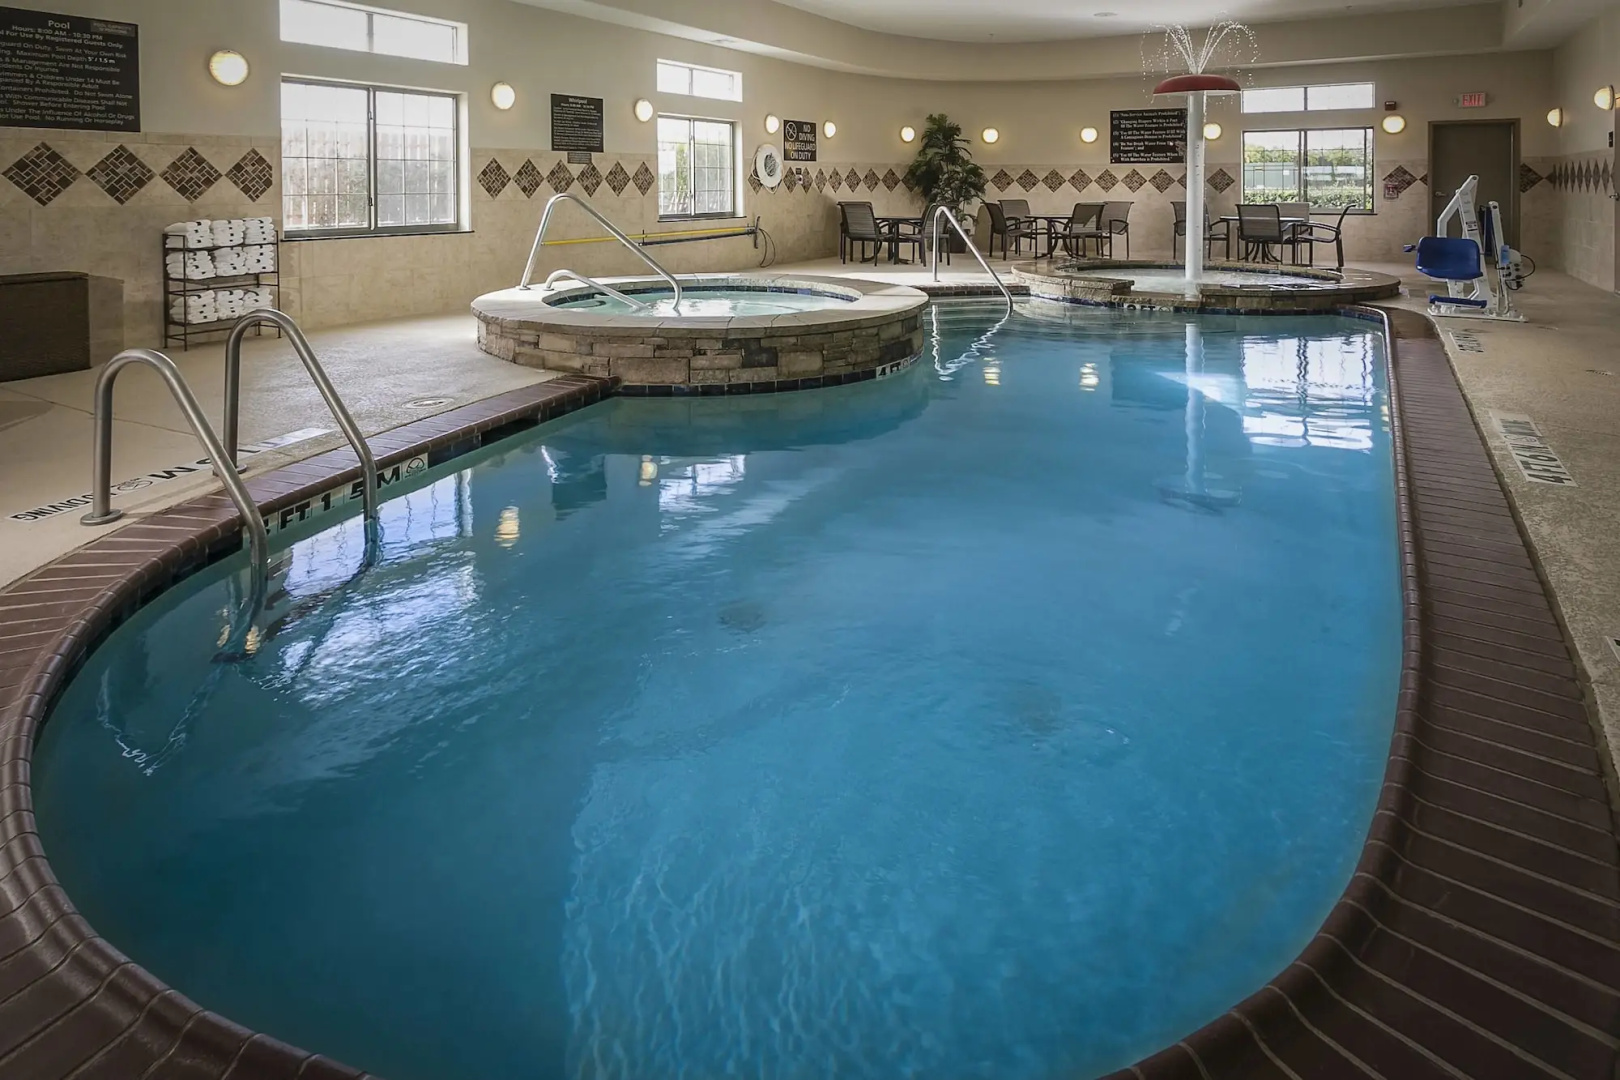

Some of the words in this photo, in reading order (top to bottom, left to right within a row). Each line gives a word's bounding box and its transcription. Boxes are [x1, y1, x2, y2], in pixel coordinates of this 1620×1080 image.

[48, 20, 70, 29] Pool
[1462, 93, 1484, 106] EXIT
[798, 133, 815, 141] DIVING
[785, 141, 792, 150] NO
[793, 142, 816, 151] LIFEGUARD
[377, 466, 401, 488] M
[10, 498, 91, 521] DIVING
